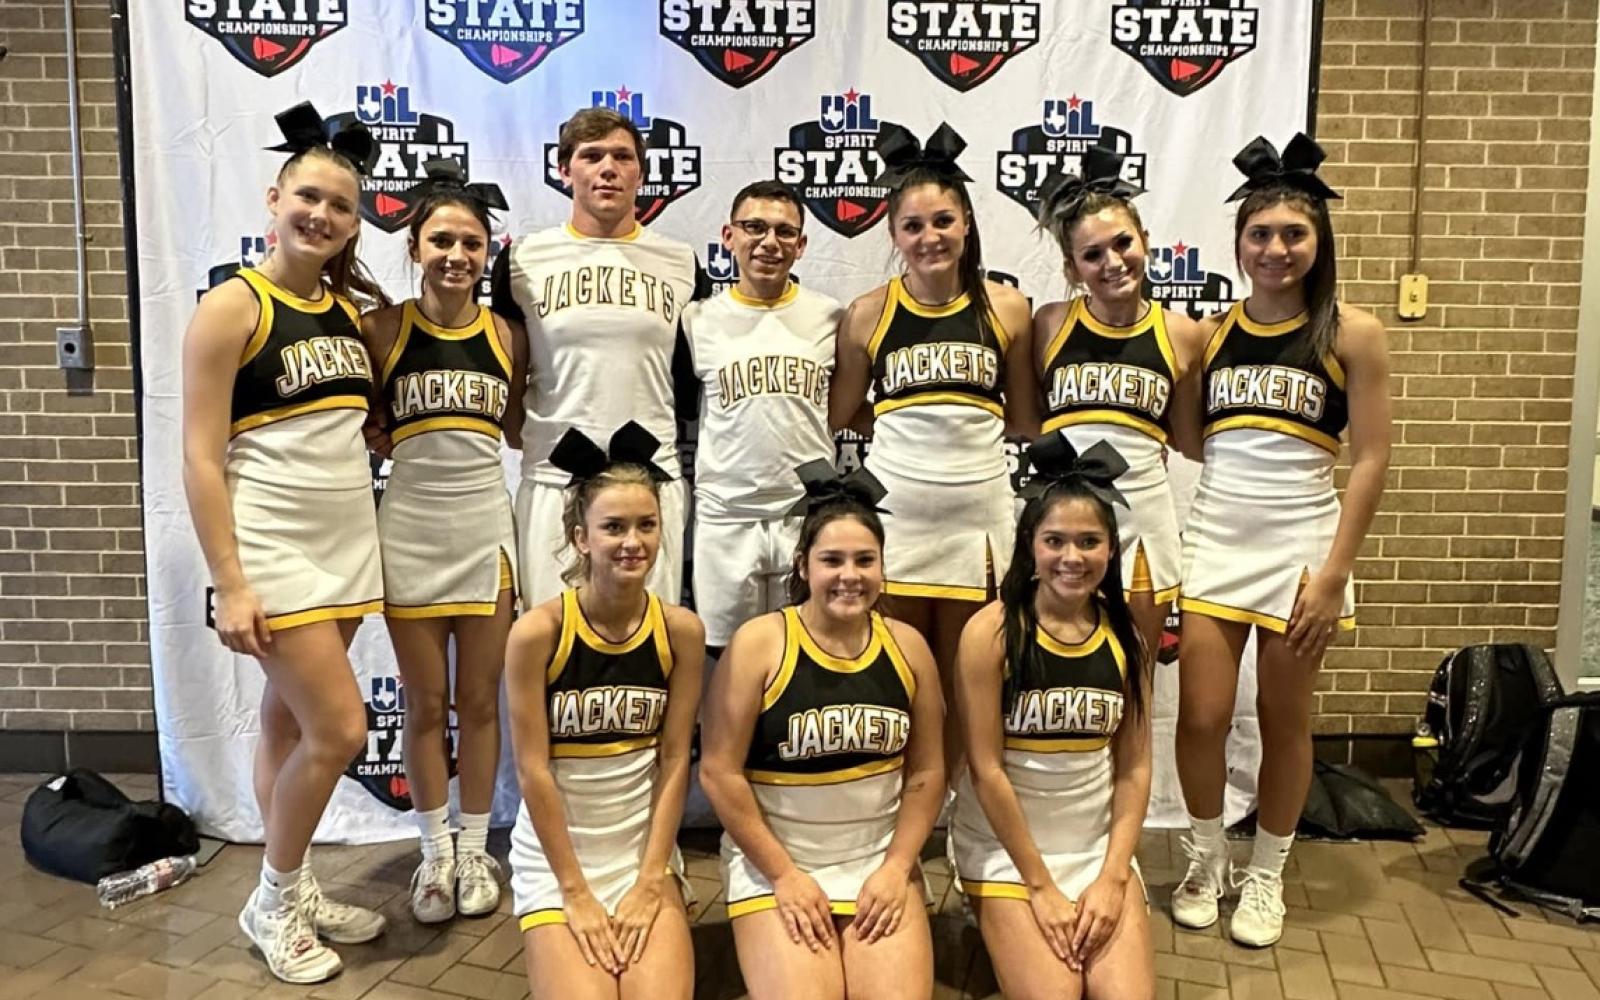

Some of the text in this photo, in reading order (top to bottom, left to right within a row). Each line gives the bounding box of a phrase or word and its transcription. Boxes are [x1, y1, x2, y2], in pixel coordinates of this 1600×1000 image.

[217, 22, 316, 35] CHAMPIONSHIPS
[429, 0, 580, 28] STATE
[663, 0, 811, 33] STATE
[891, 2, 1036, 38] STATE
[1115, 8, 1255, 43] STATE
[456, 28, 553, 42] CHAMPIONSHIPS
[690, 35, 784, 47] CHAMPIONSHIPS
[918, 39, 1009, 52] CHAMPIONSHIPS
[1140, 45, 1228, 56] CHAMPIONSHIPS
[368, 127, 416, 140] PIRIT
[824, 135, 877, 148] SPIRIT
[779, 150, 886, 184] STAT
[1000, 154, 1142, 187] STAE
[805, 186, 891, 198] CHAMPIONSHIP
[537, 265, 674, 323] JACKETS
[1152, 286, 1203, 298] SPIRIT
[276, 336, 373, 398] JACKE
[882, 341, 998, 396] JACKETS
[391, 369, 509, 422] JACKETS
[1048, 361, 1171, 420] JACKETS
